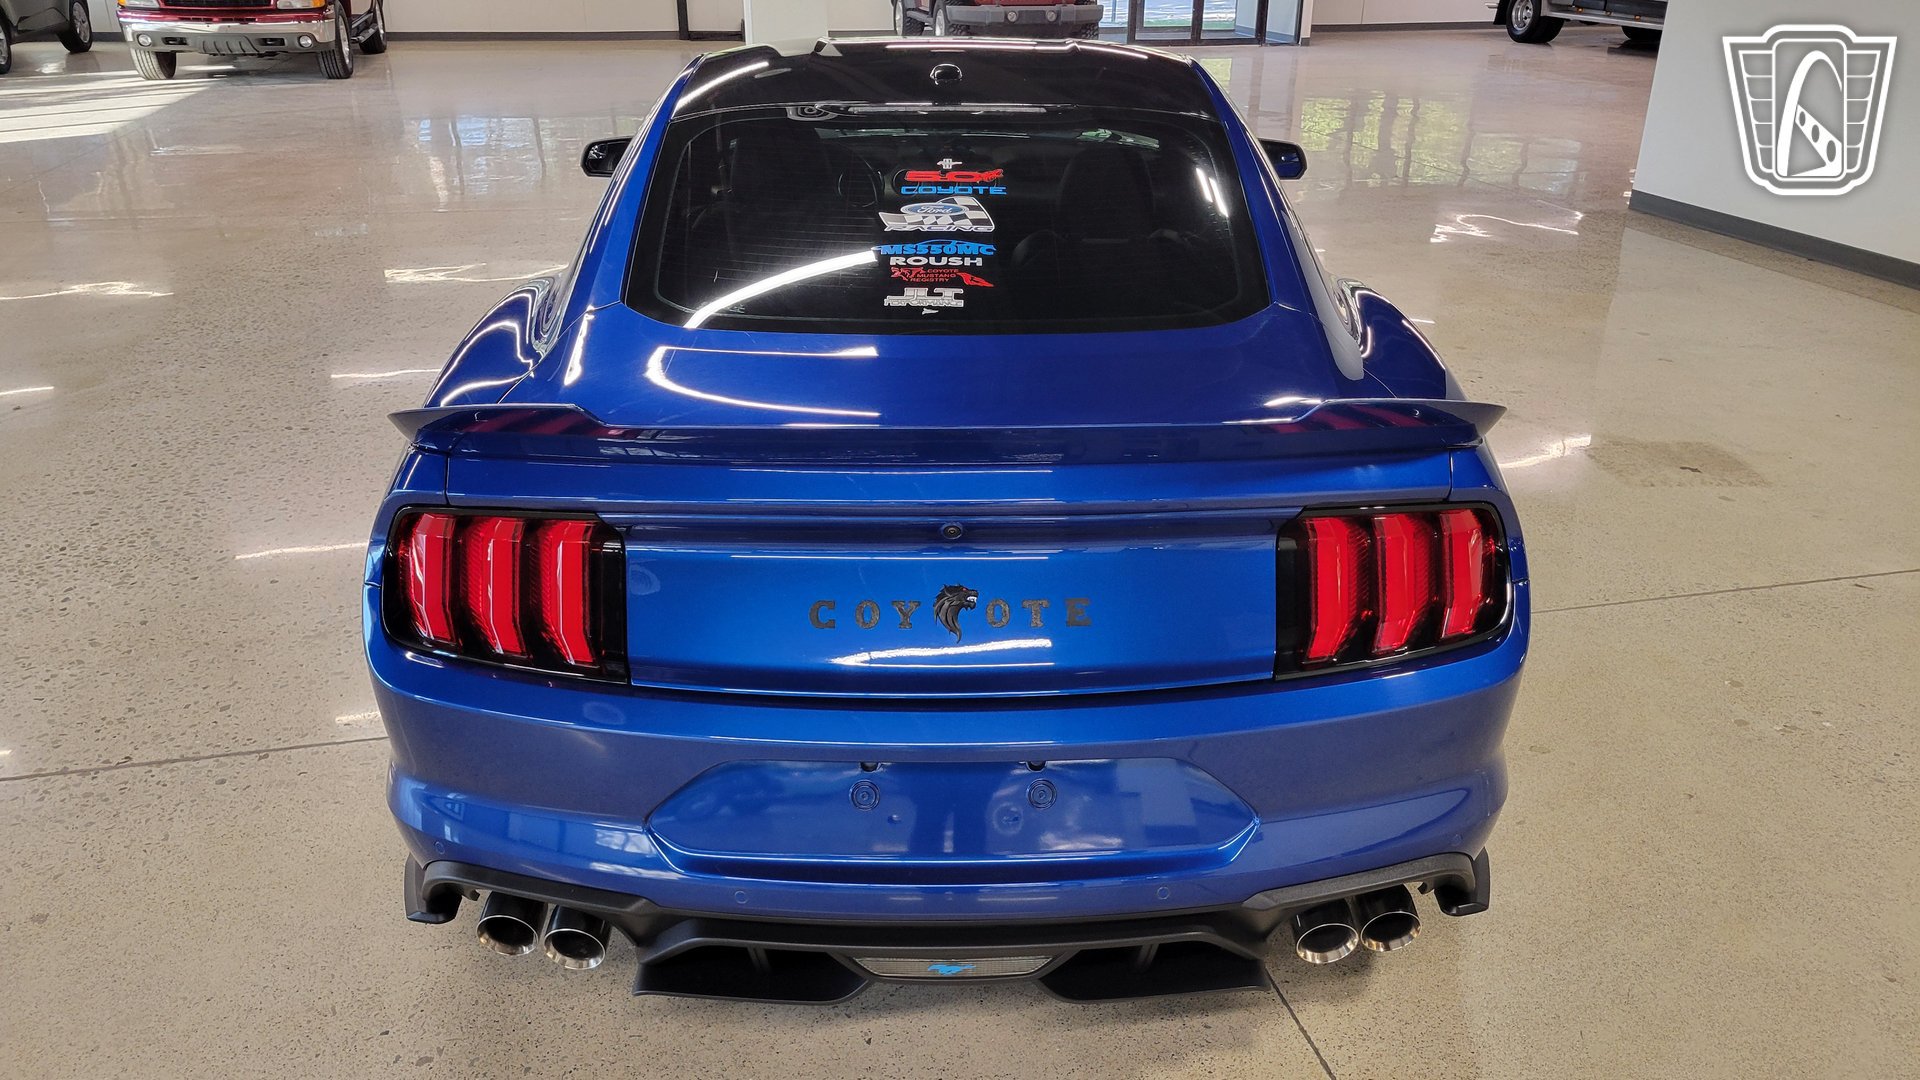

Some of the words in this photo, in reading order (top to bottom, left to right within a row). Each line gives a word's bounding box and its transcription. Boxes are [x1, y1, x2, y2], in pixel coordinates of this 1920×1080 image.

[901, 186, 1007, 195] COYOTE
[916, 205, 952, 214] Ford
[880, 244, 995, 255] MS550MC
[889, 256, 983, 266] ROUSH
[886, 287, 964, 300] JLT
